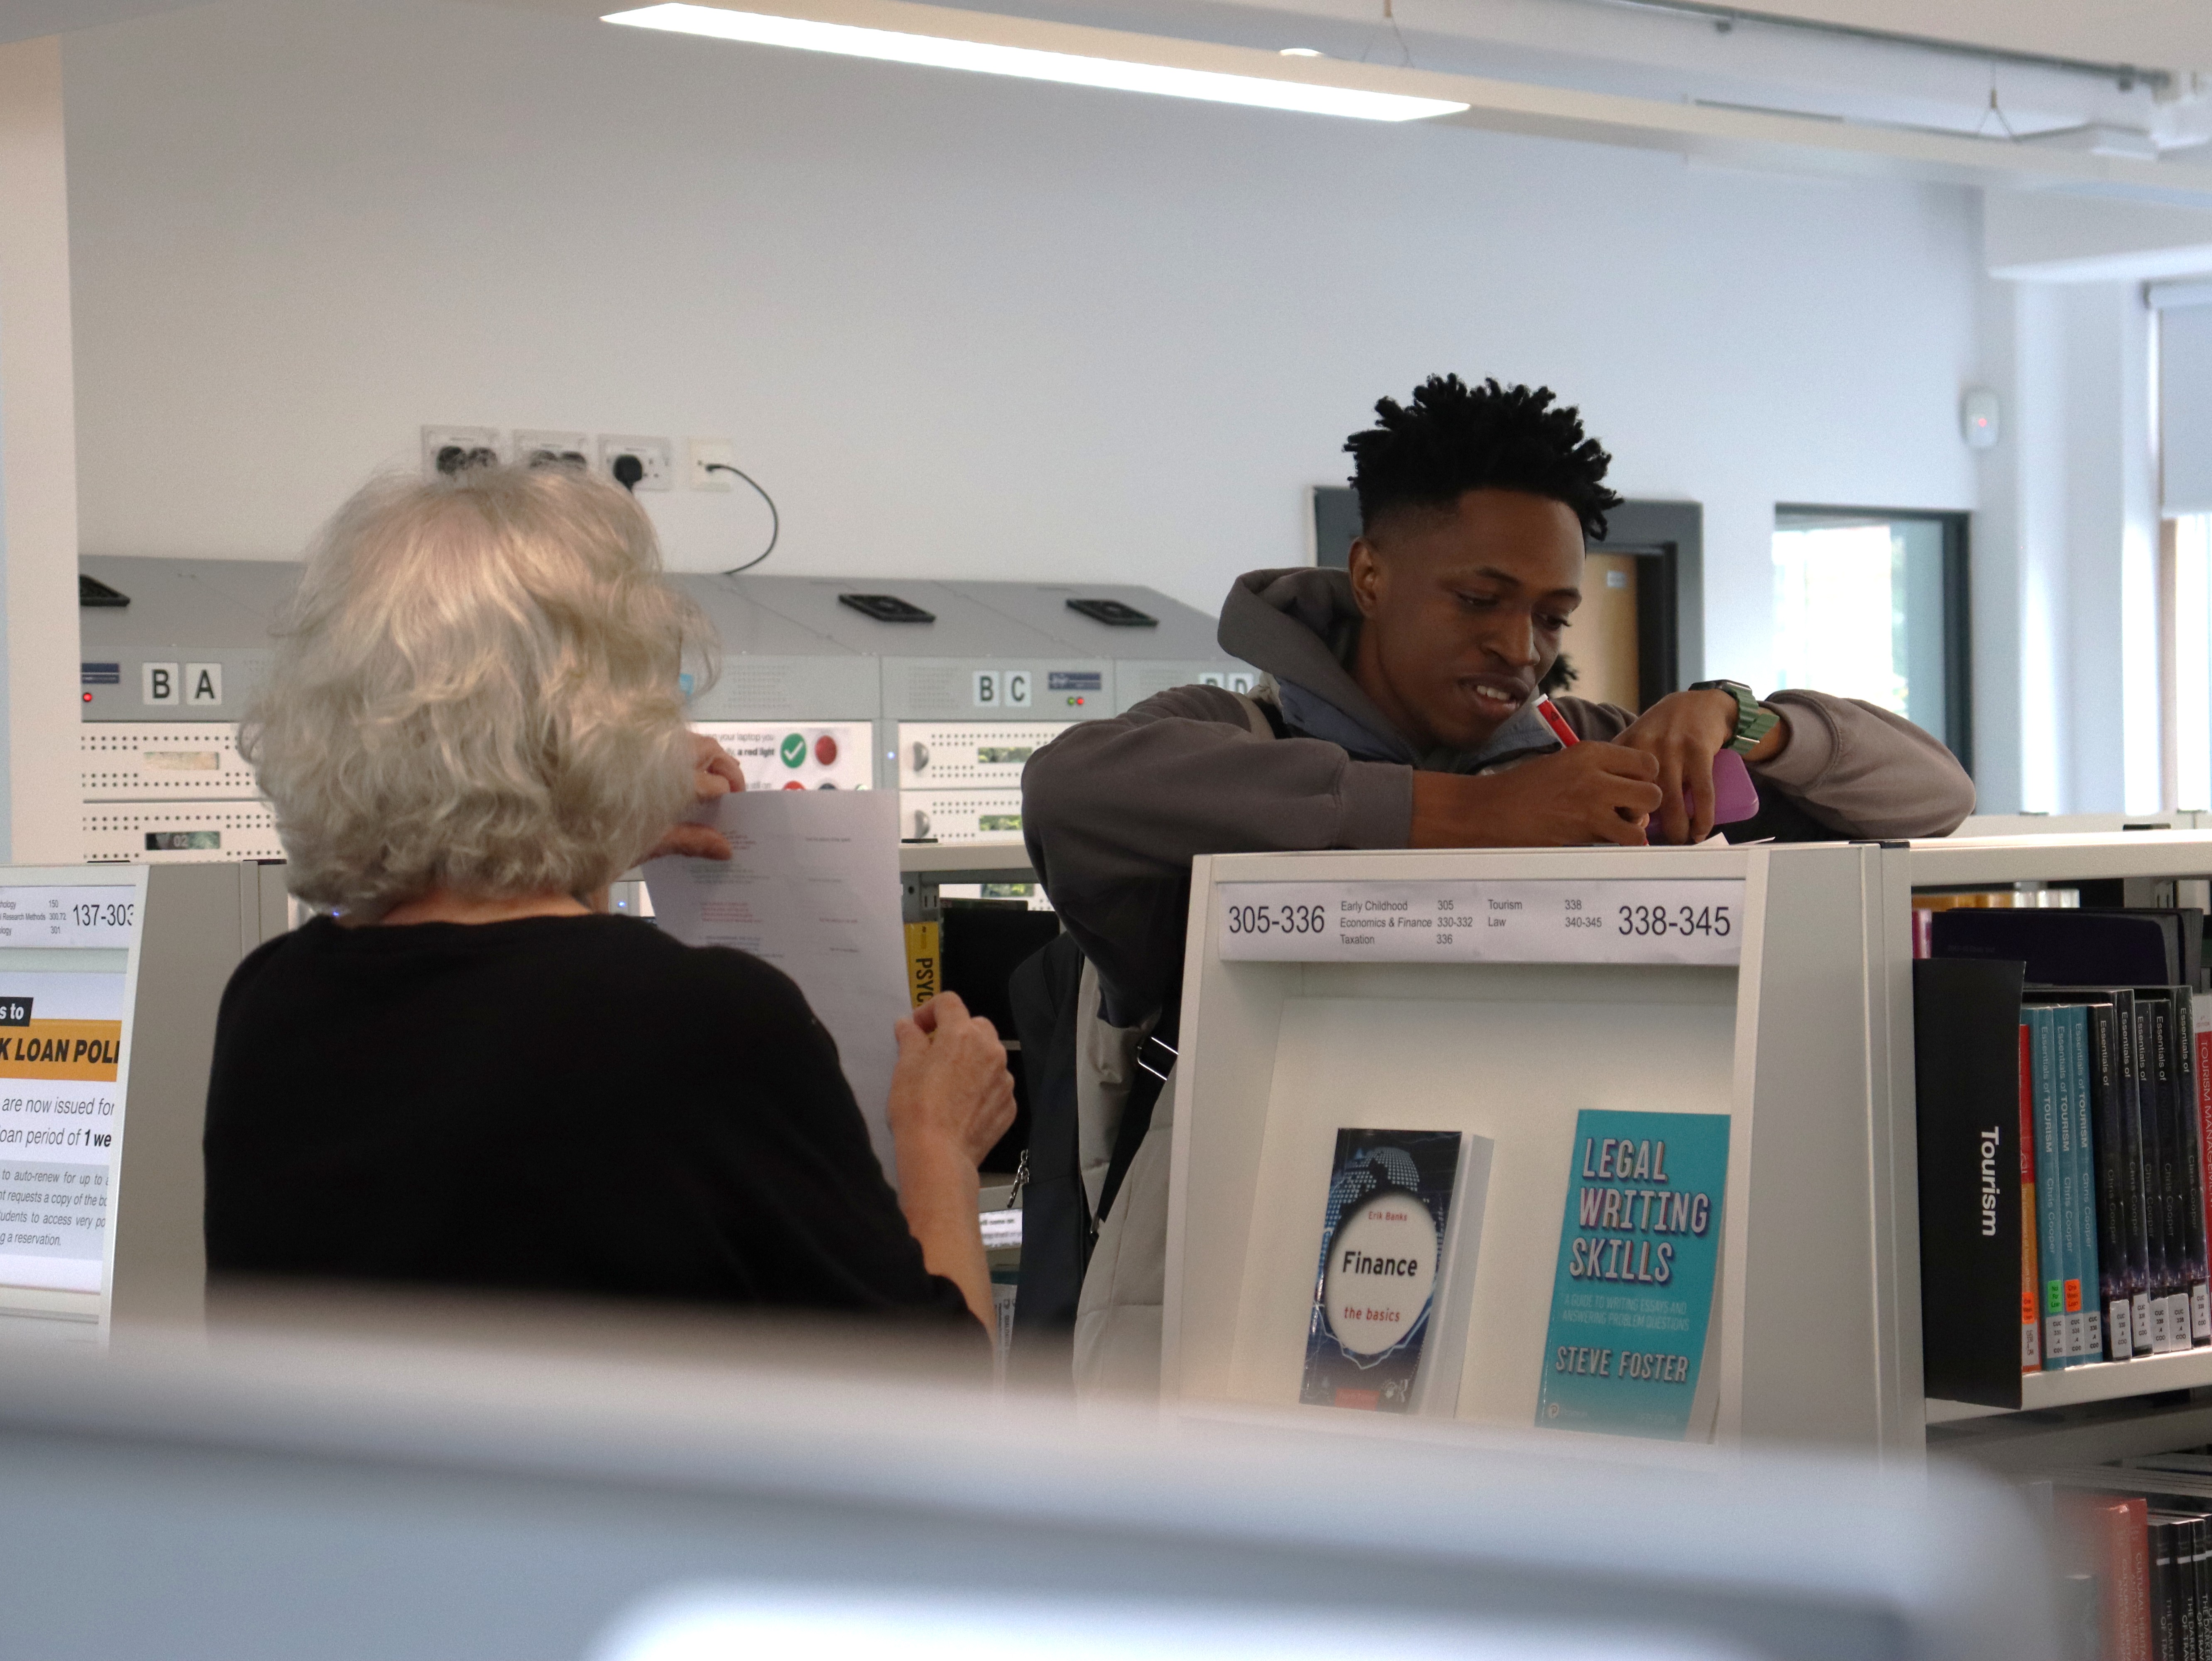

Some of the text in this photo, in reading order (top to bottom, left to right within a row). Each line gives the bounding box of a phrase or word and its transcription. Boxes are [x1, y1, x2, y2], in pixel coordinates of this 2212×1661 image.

[1341, 900, 1453, 913] Early Childhood 305
[1488, 899, 1582, 910] Tourism 338
[1229, 906, 1325, 933] 305-336
[1340, 917, 1473, 928] Economics & Finance 330-332
[1488, 917, 1602, 927] Law 340-345
[1619, 906, 1730, 936] 338-345
[1340, 934, 1453, 944] Taxation 336
[10, 1003, 24, 1020] to
[2121, 1012, 2130, 1064] Essentials
[2157, 1017, 2166, 1068] Essentials
[15, 1038, 70, 1062] LOAN
[2124, 1067, 2131, 1078] of
[2140, 1071, 2147, 1081] of
[2159, 1071, 2166, 1081] of
[2183, 1063, 2190, 1073] of
[2201, 1041, 2211, 1100] TOURISM
[2043, 1083, 2050, 1093] of
[2058, 1026, 2070, 1151] Essentials of TOURISM
[2075, 1023, 2088, 1148] Essentials of TOURISM
[2103, 1076, 2109, 1086] of
[2, 1098, 22, 1112] are
[25, 1099, 51, 1113] now
[54, 1097, 95, 1115] issued
[2044, 1096, 2053, 1153] TOURISM
[0, 1125, 111, 1148] oan period of 1 we
[1582, 1138, 1667, 1181] LEGAL
[2, 1169, 10, 1180] to
[14, 1170, 60, 1183] auto-renew
[64, 1172, 76, 1184] for
[80, 1175, 90, 1188] up
[94, 1174, 102, 1186] to
[1981, 1126, 2000, 1237] Tourism
[7, 1191, 97, 1207] requests a copy of the
[0, 1210, 27, 1222] udents
[31, 1212, 39, 1223] to
[43, 1215, 72, 1225] access
[76, 1217, 93, 1229] very
[1369, 1212, 1407, 1221] Erik Banks
[1579, 1187, 1710, 1235] WRITING
[7, 1233, 61, 1246] a reservation.
[1343, 1251, 1417, 1276] Finance
[1570, 1237, 1673, 1283] SKILLS
[1344, 1307, 1400, 1322] the basics
[1556, 1346, 1689, 1382] STEVE FOSTER
[2161, 1616, 2166, 1632] OF
[2182, 1615, 2188, 1629] OF
[2197, 1612, 2203, 1628] OF
